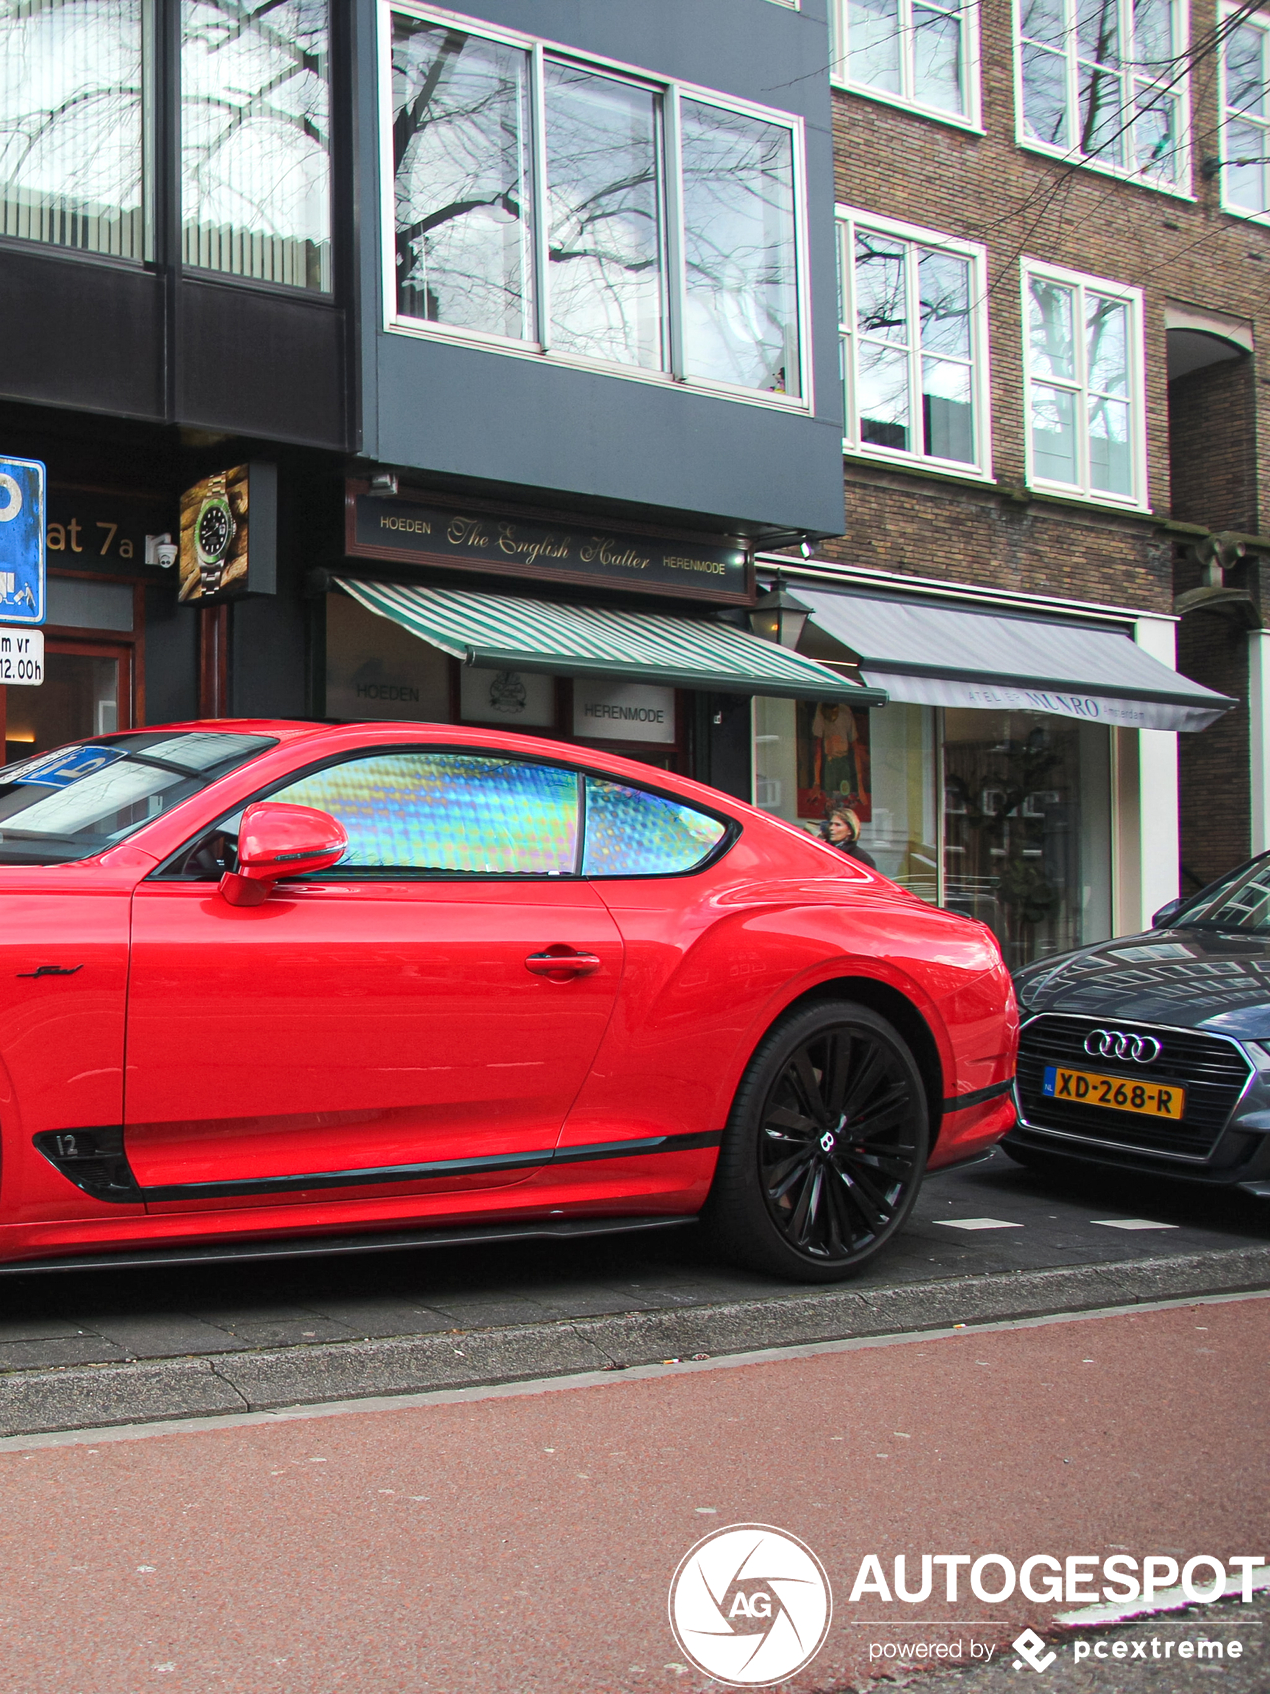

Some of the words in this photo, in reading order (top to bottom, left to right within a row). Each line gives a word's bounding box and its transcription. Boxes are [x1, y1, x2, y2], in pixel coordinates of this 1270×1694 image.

[380, 516, 431, 534] HOEDEN
[447, 515, 490, 548] The
[494, 521, 571, 565] English
[663, 556, 726, 575] HERENMODE
[17, 638, 30, 654] vr
[356, 682, 420, 702] HOEDEN
[584, 702, 665, 723] HERENMODE
[1024, 691, 1099, 718] MUNRO
[1044, 1083, 1053, 1092] NL
[1058, 1072, 1173, 1114] XD-268-R
[56, 1134, 78, 1156] 12
